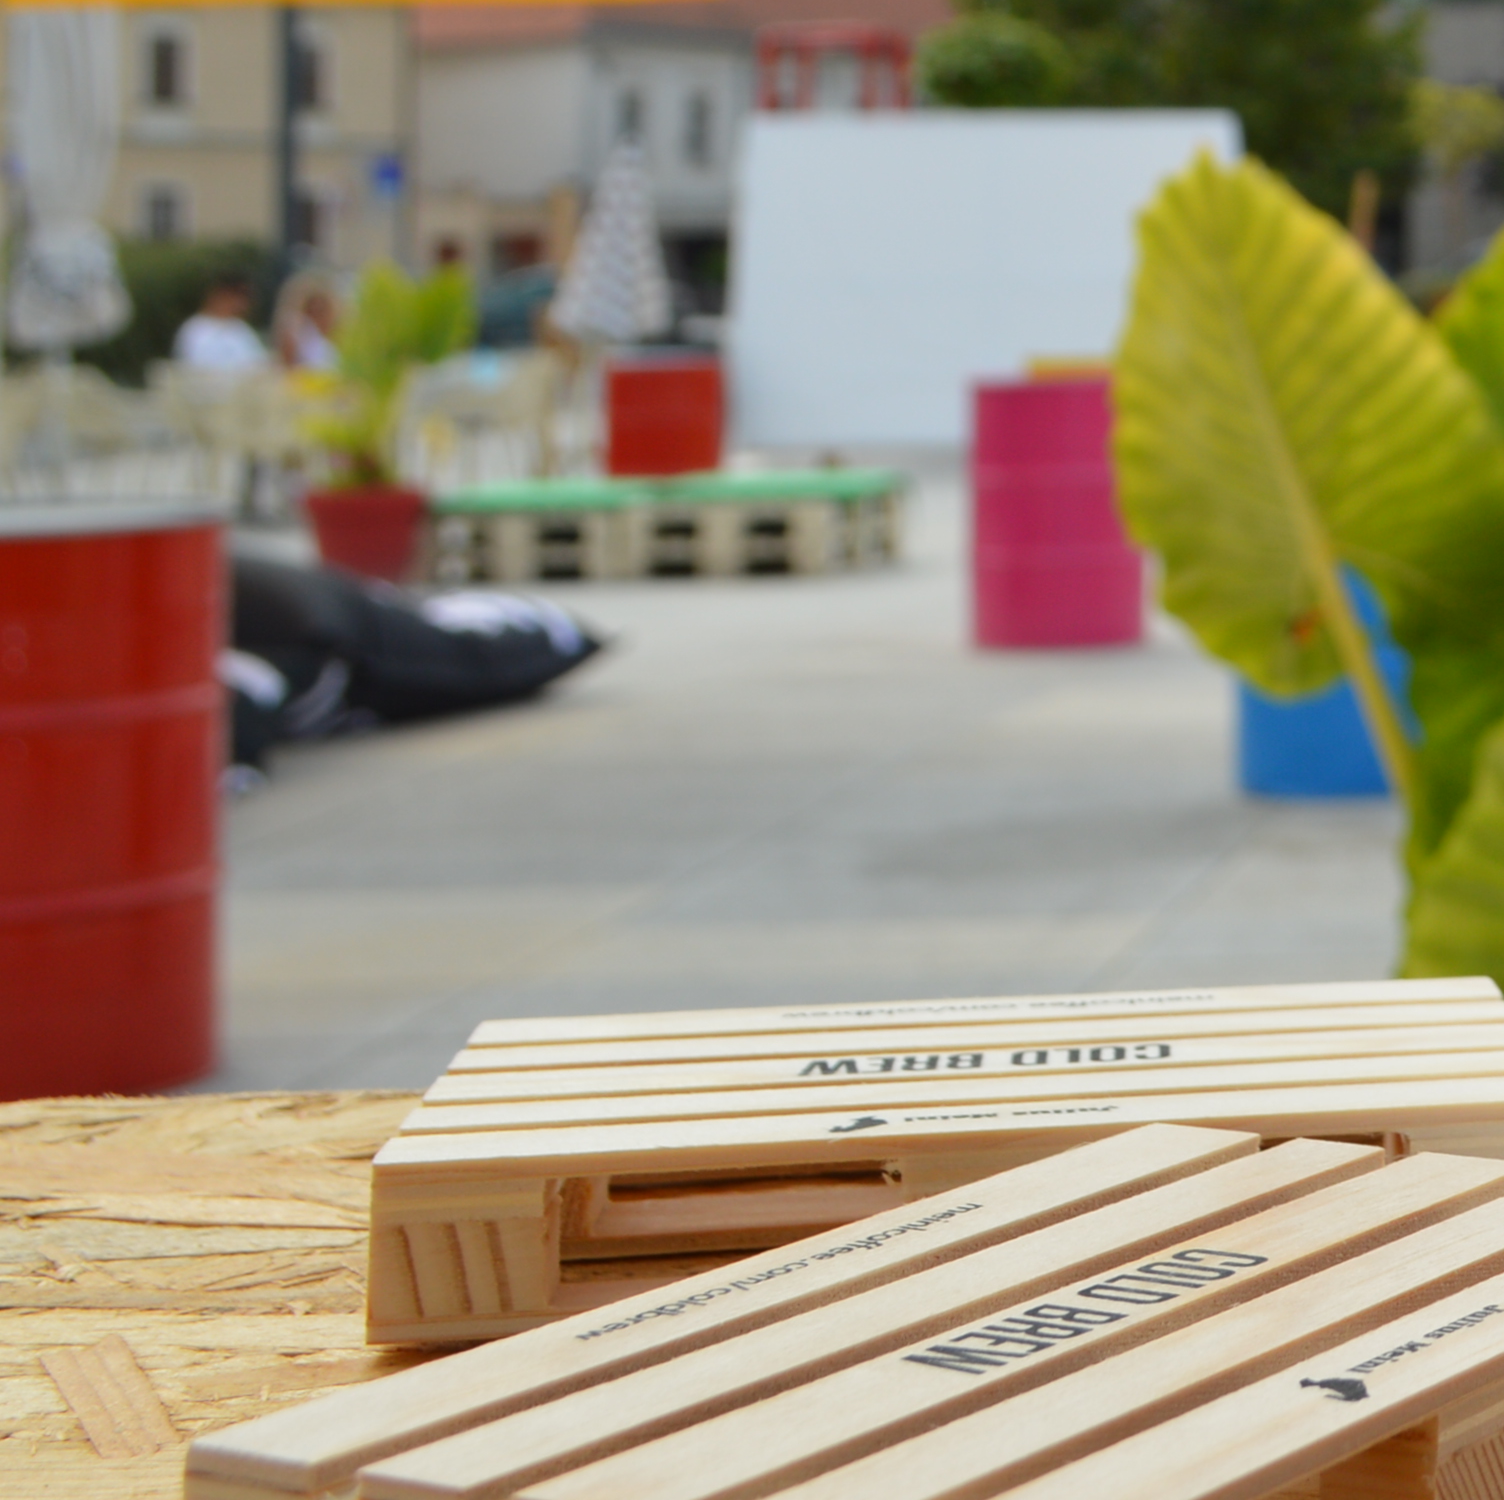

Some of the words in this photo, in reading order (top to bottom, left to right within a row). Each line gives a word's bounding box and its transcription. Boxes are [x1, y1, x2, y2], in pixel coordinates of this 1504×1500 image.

[799, 1052, 984, 1077] BREW
[1010, 1043, 1172, 1067] COLD
[575, 1202, 983, 1341] meinlcoffee.com/coldbrew
[1077, 1248, 1269, 1305] COLD
[902, 1303, 1130, 1375] BREW
[1346, 1340, 1432, 1374] Meinl
